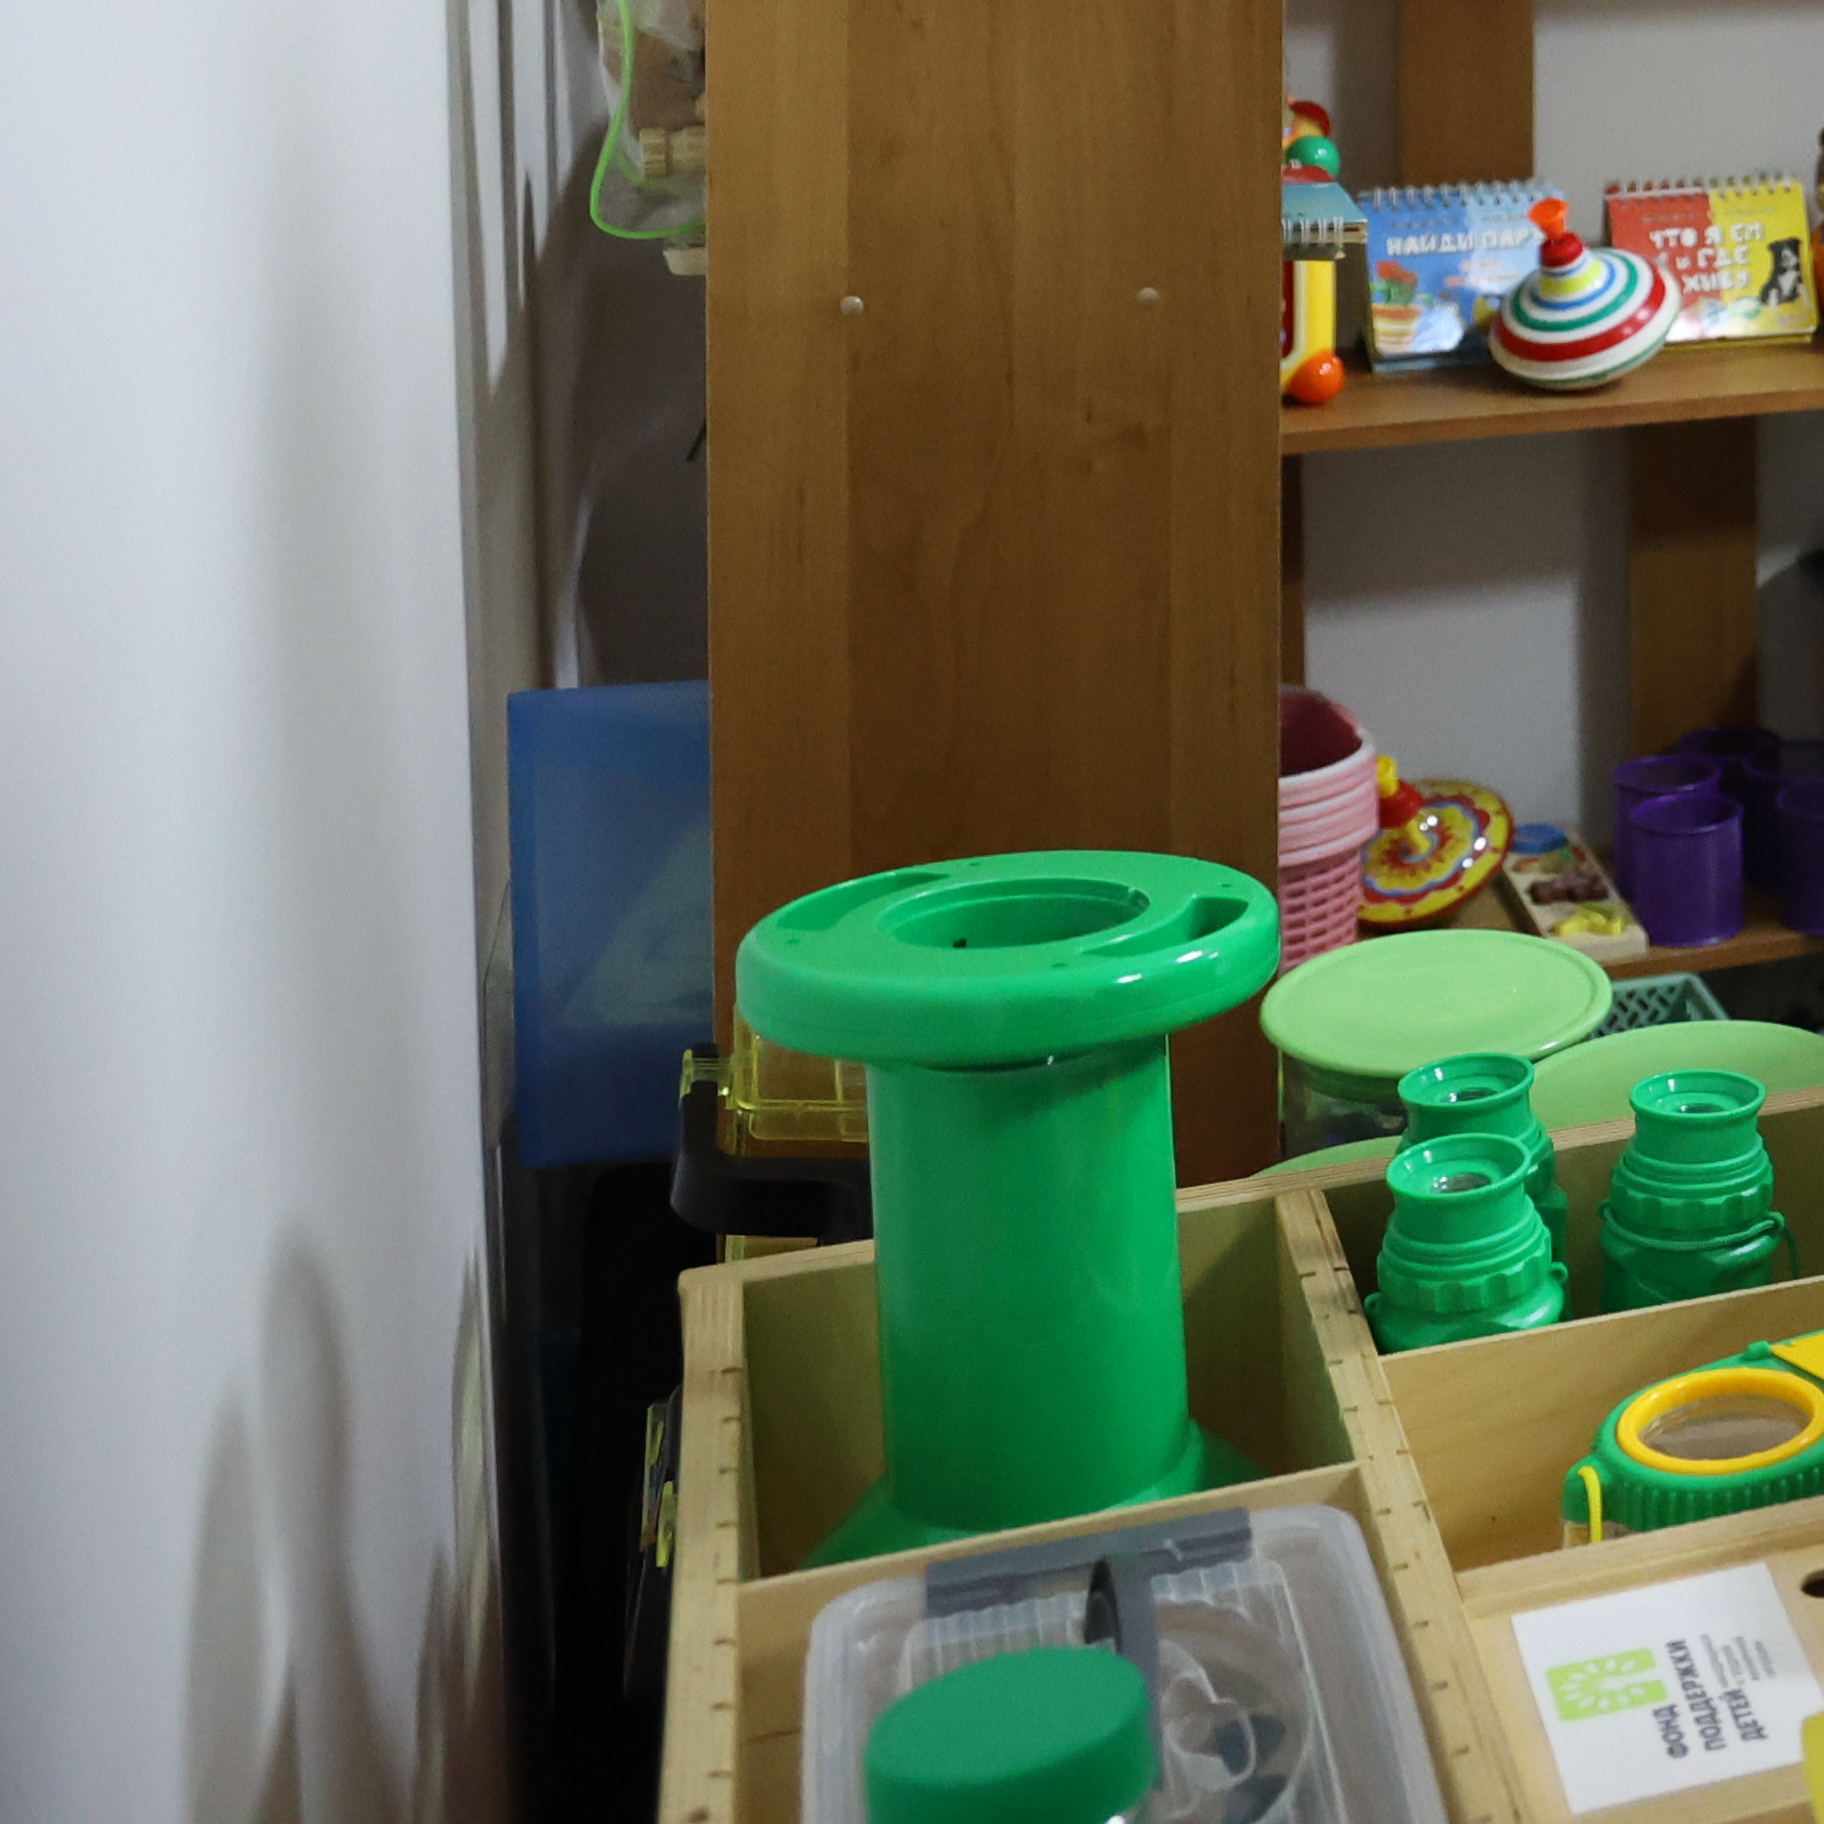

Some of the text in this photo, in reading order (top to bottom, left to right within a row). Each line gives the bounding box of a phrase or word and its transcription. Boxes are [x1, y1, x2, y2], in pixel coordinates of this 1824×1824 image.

[1665, 1639, 1728, 1752] ПОДДЕРЖКИ
[1718, 1689, 1769, 1742] ДЕТЕЙ
[1653, 1704, 1689, 1758] ФОНД
